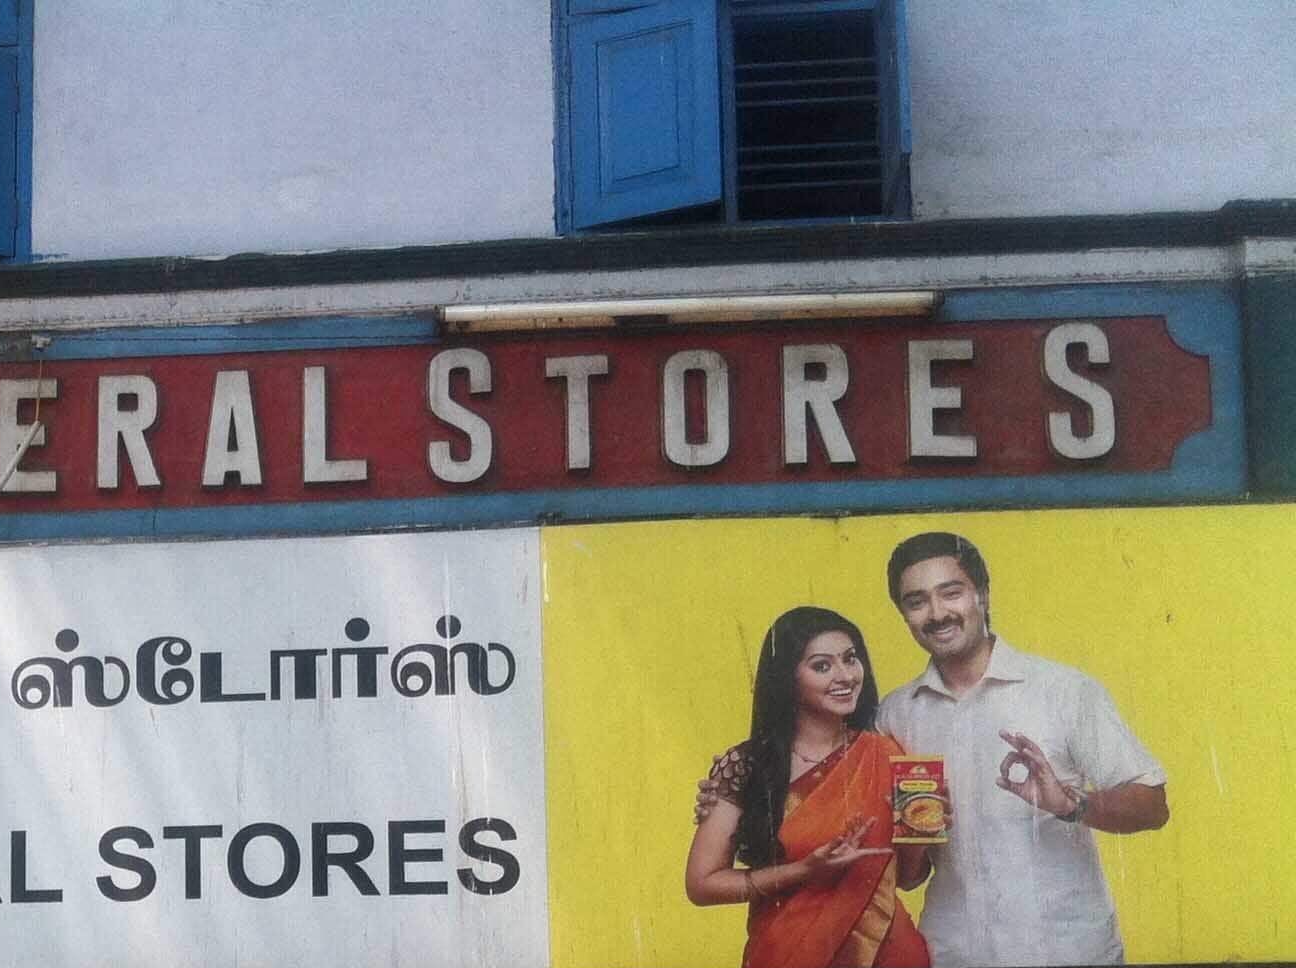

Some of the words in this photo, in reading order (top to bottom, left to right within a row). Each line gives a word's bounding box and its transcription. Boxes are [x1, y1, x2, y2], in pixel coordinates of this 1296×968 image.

[426, 321, 1116, 485] STORES
[10, 614, 516, 711] ஸ்டோர்ஸ்
[95, 817, 522, 904] STORES
